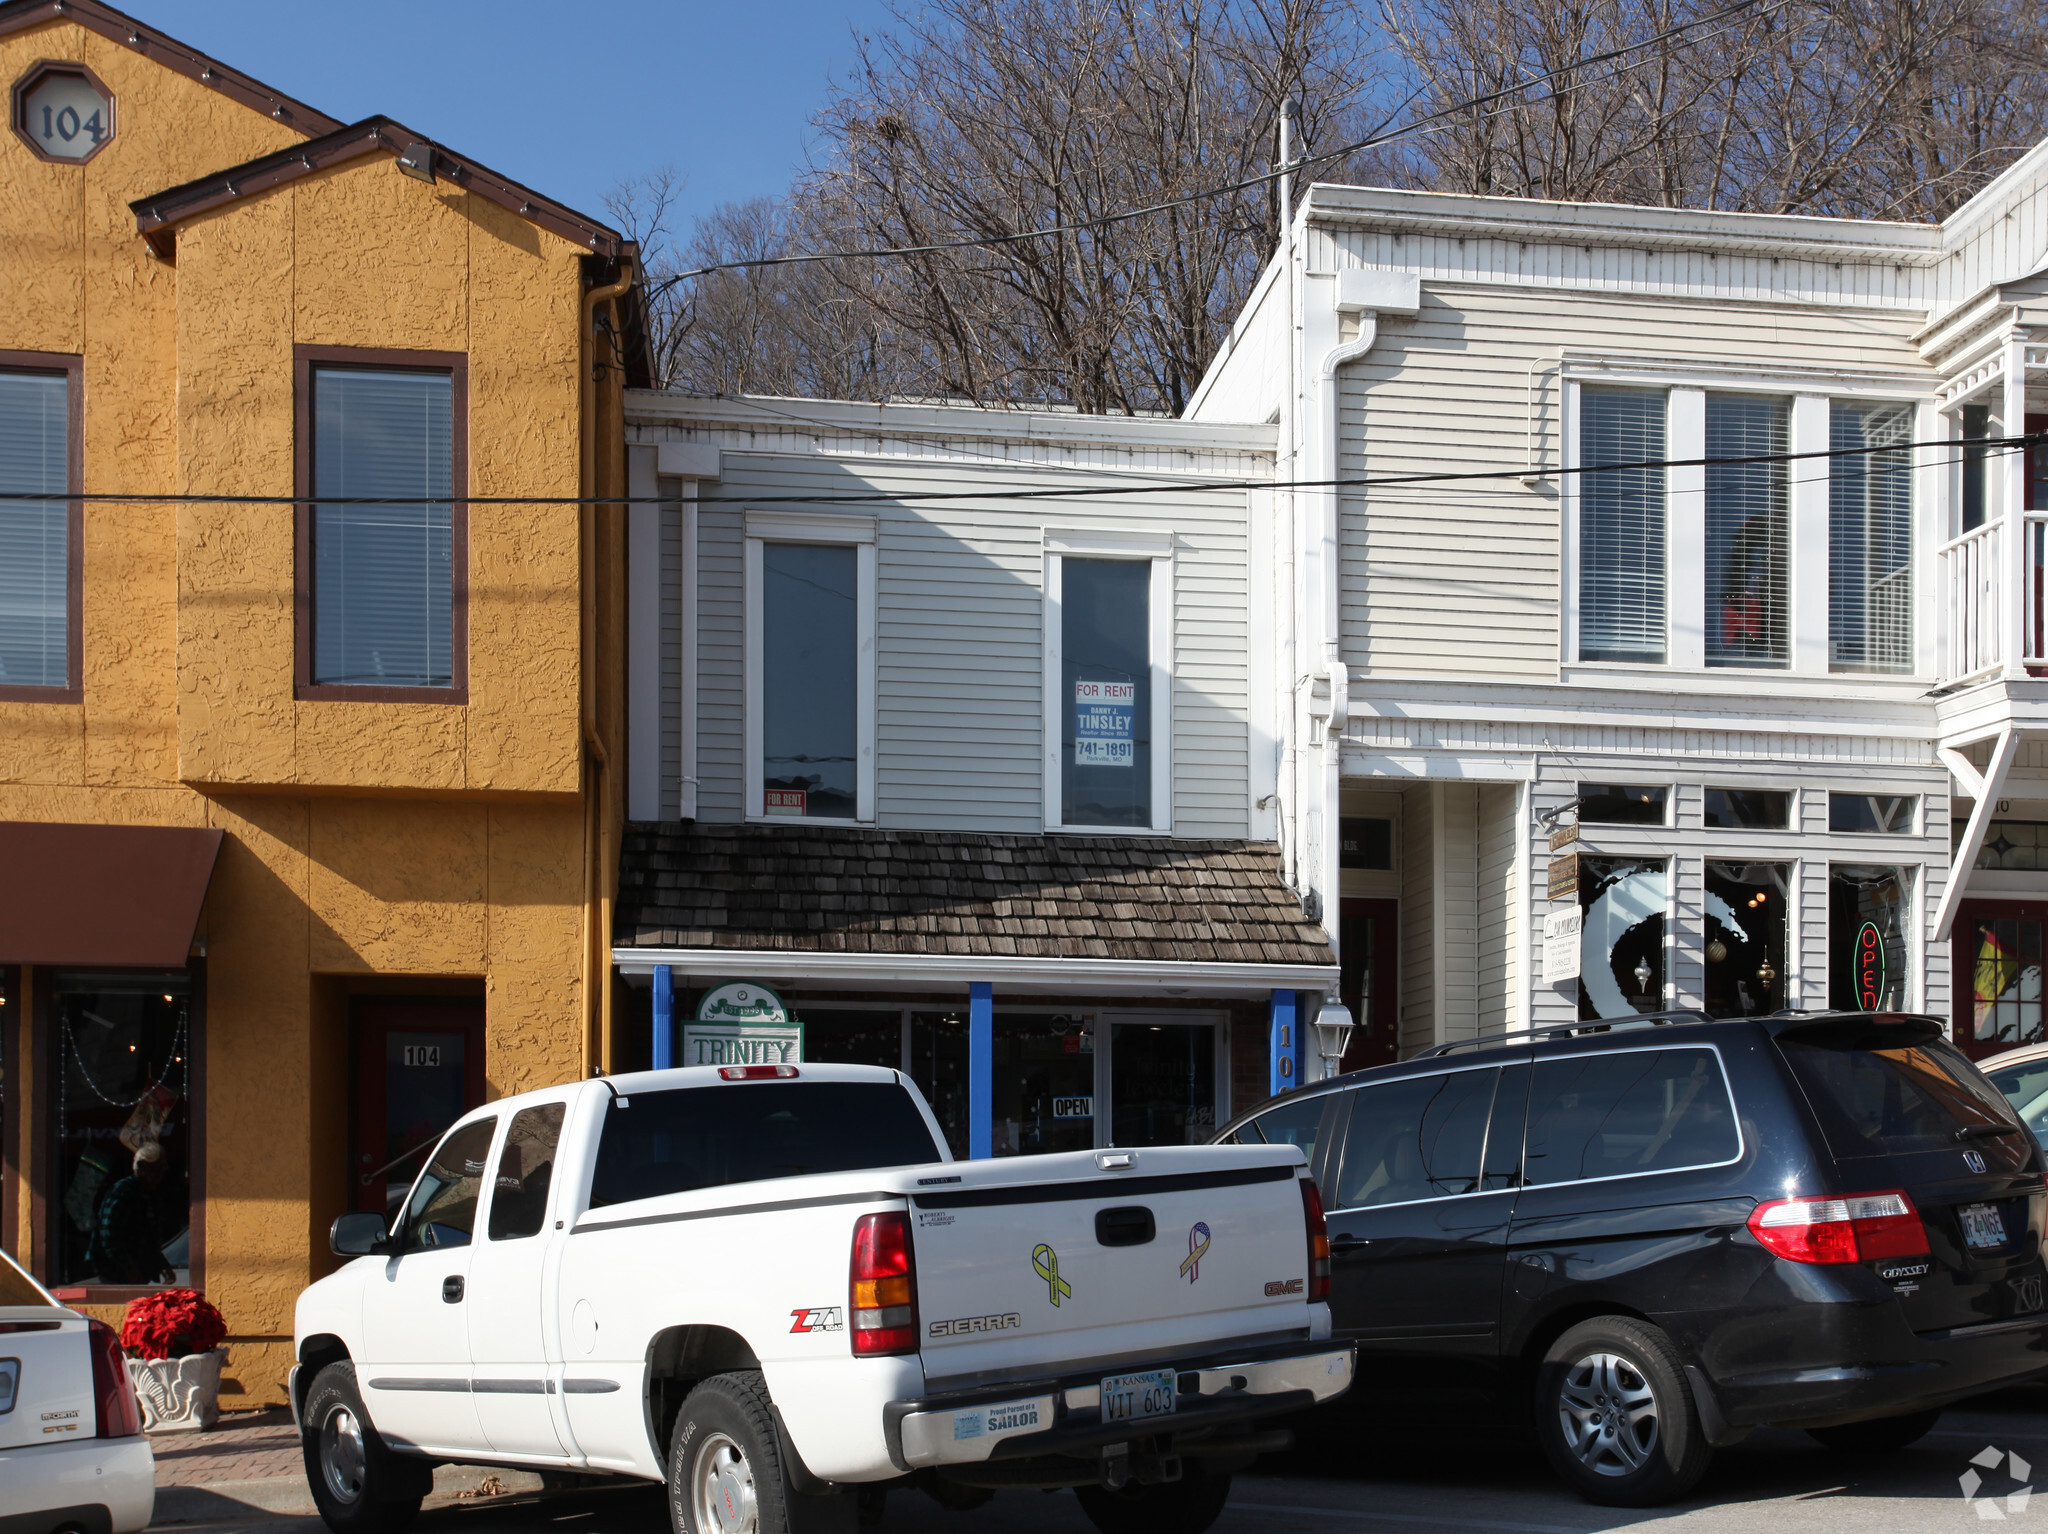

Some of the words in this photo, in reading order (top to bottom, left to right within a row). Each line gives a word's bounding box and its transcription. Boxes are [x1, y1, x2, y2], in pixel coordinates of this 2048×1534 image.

[41, 104, 106, 146] 104
[1076, 684, 1099, 696] FOR
[1105, 685, 1134, 697] RENT
[1090, 707, 1111, 715] DANNY
[1078, 714, 1131, 730] TINSLEY
[1078, 741, 1131, 757] 741-1891
[767, 793, 781, 805] FOR
[783, 794, 802, 805] RENT
[1862, 929, 1876, 1009] OPEN
[724, 1005, 737, 1014] EST
[407, 1046, 439, 1066] 104
[693, 1038, 795, 1065] TRINITY
[1279, 1024, 1292, 1093] 10
[1055, 1099, 1090, 1116] OPEN
[1882, 1264, 1929, 1279] ODYSSEY
[1265, 1278, 1304, 1297] GMC
[789, 1306, 843, 1333] Z71
[825, 1324, 843, 1332] ROAD
[929, 1312, 1021, 1338] SIERRA
[1122, 1373, 1155, 1387] KANSAS
[990, 1407, 1006, 1416] Proud
[1007, 1404, 1025, 1414] Parent
[1025, 1403, 1031, 1411] of
[1106, 1391, 1134, 1419] VIT
[1144, 1386, 1172, 1413] 603
[988, 1411, 1038, 1431] SAILOR
[674, 1444, 685, 1495] Trail
[682, 1420, 697, 1445] T/A
